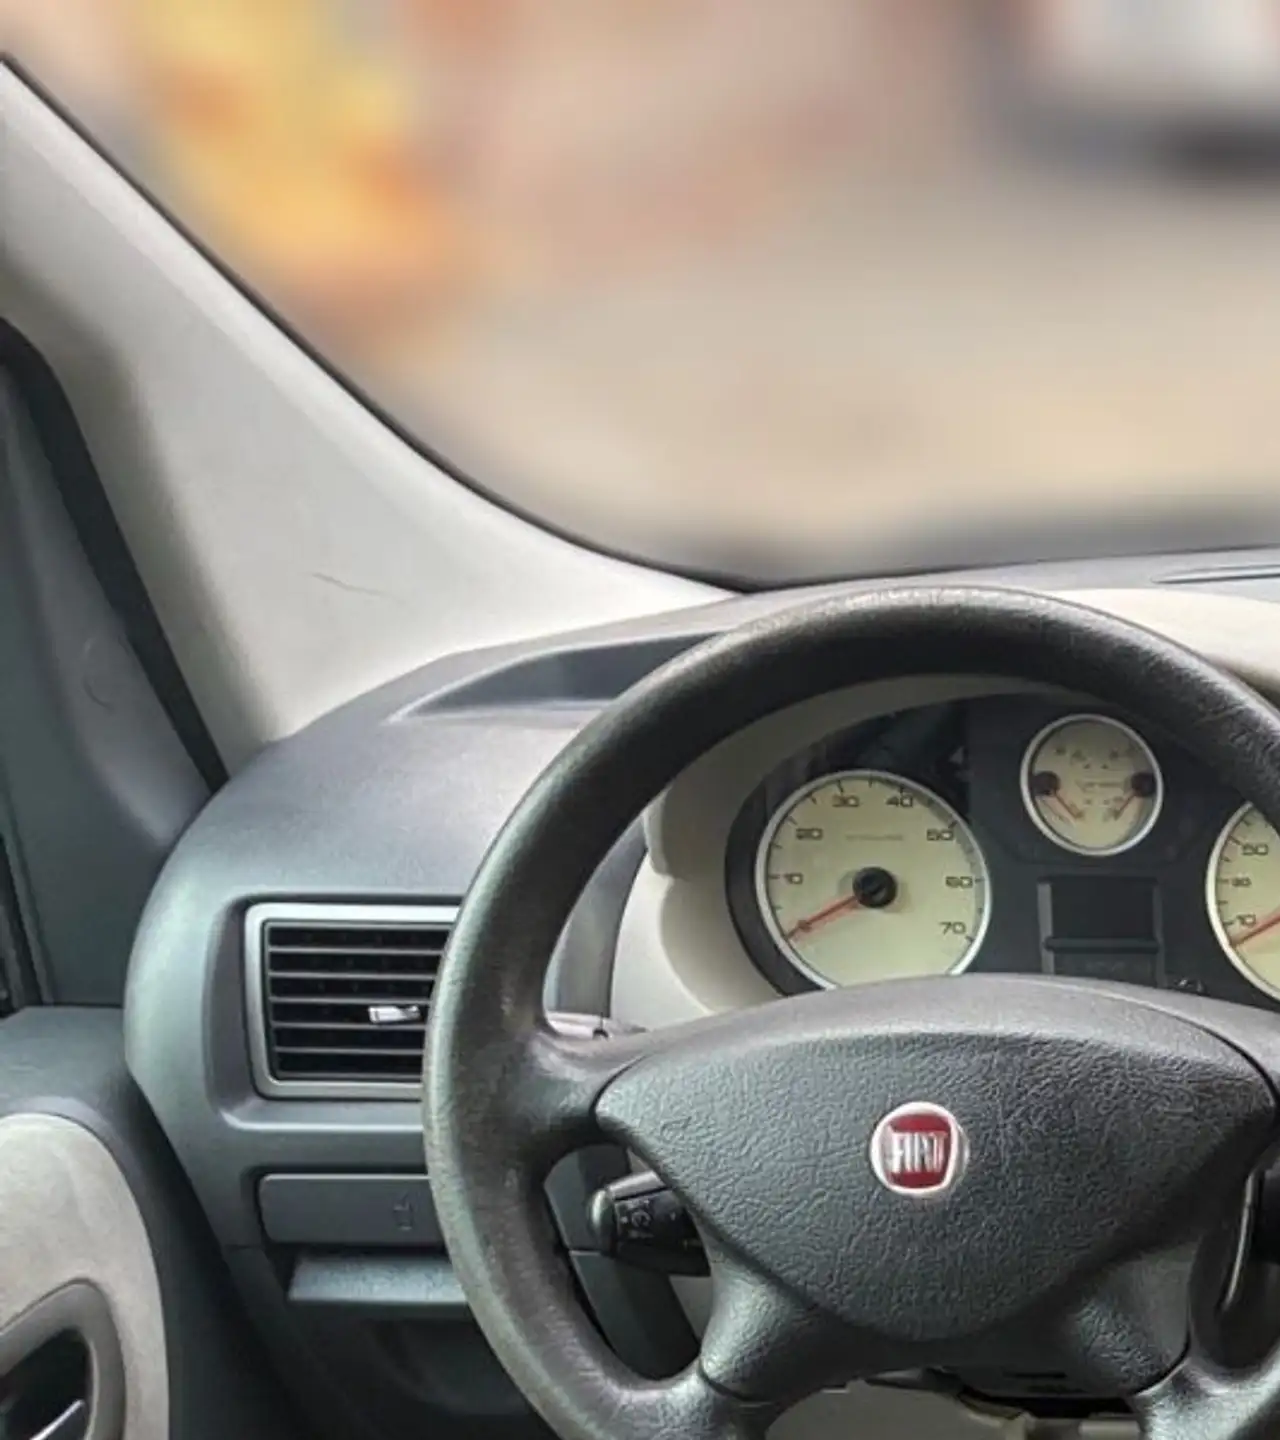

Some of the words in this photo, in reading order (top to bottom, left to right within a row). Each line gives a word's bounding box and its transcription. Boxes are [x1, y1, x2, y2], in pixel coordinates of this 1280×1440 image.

[832, 795, 860, 808] 30
[886, 795, 914, 808] 40
[783, 873, 803, 885] 10
[939, 922, 966, 935] 70
[888, 1131, 949, 1174] FIAT
